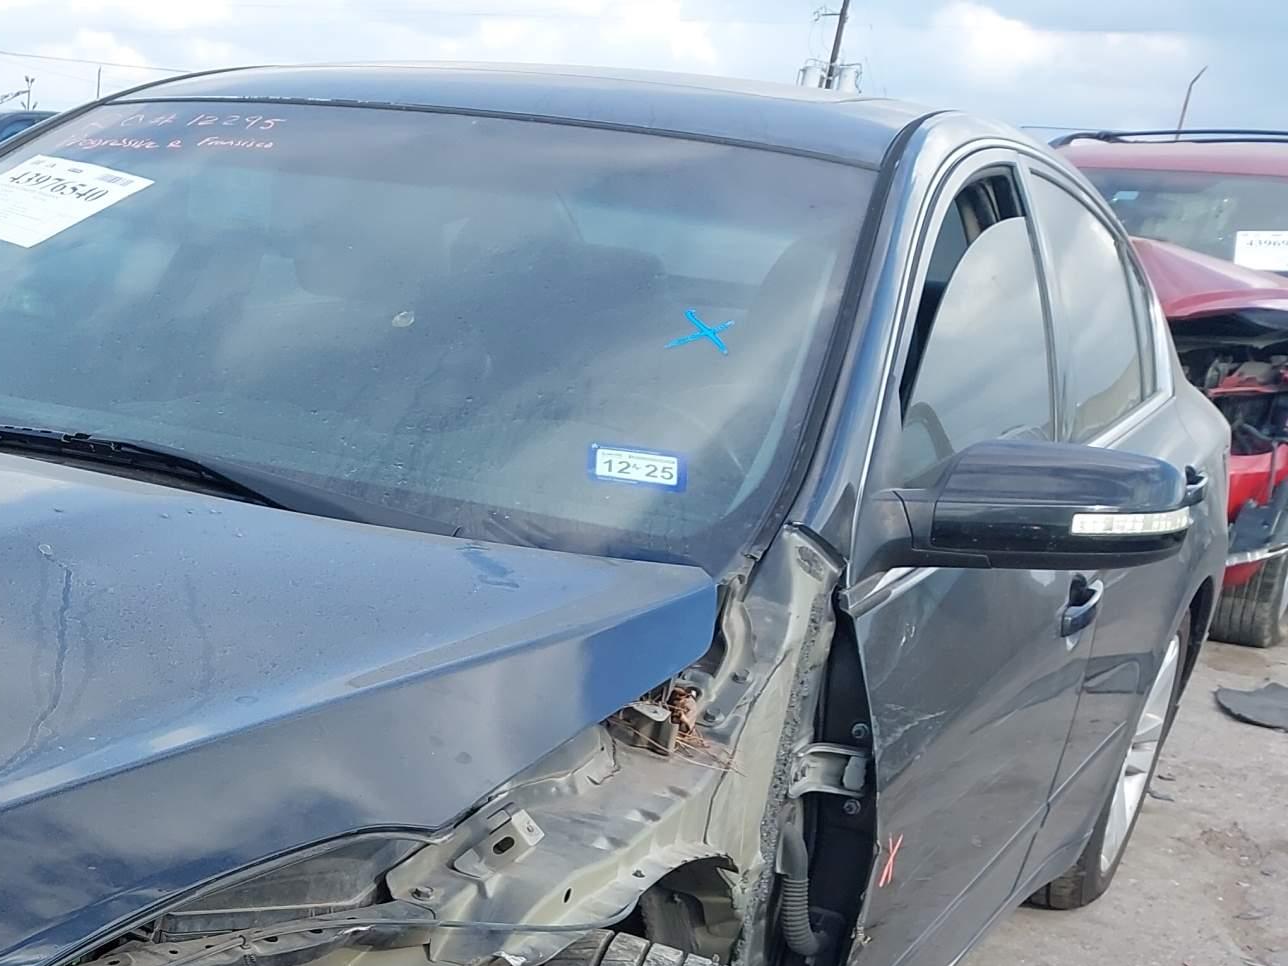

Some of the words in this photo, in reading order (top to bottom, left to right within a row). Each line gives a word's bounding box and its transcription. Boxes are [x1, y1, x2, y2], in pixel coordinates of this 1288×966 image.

[186, 113, 288, 130] 12295
[9, 171, 109, 201] 43976540
[602, 458, 631, 475] 12
[644, 464, 674, 480] 25
